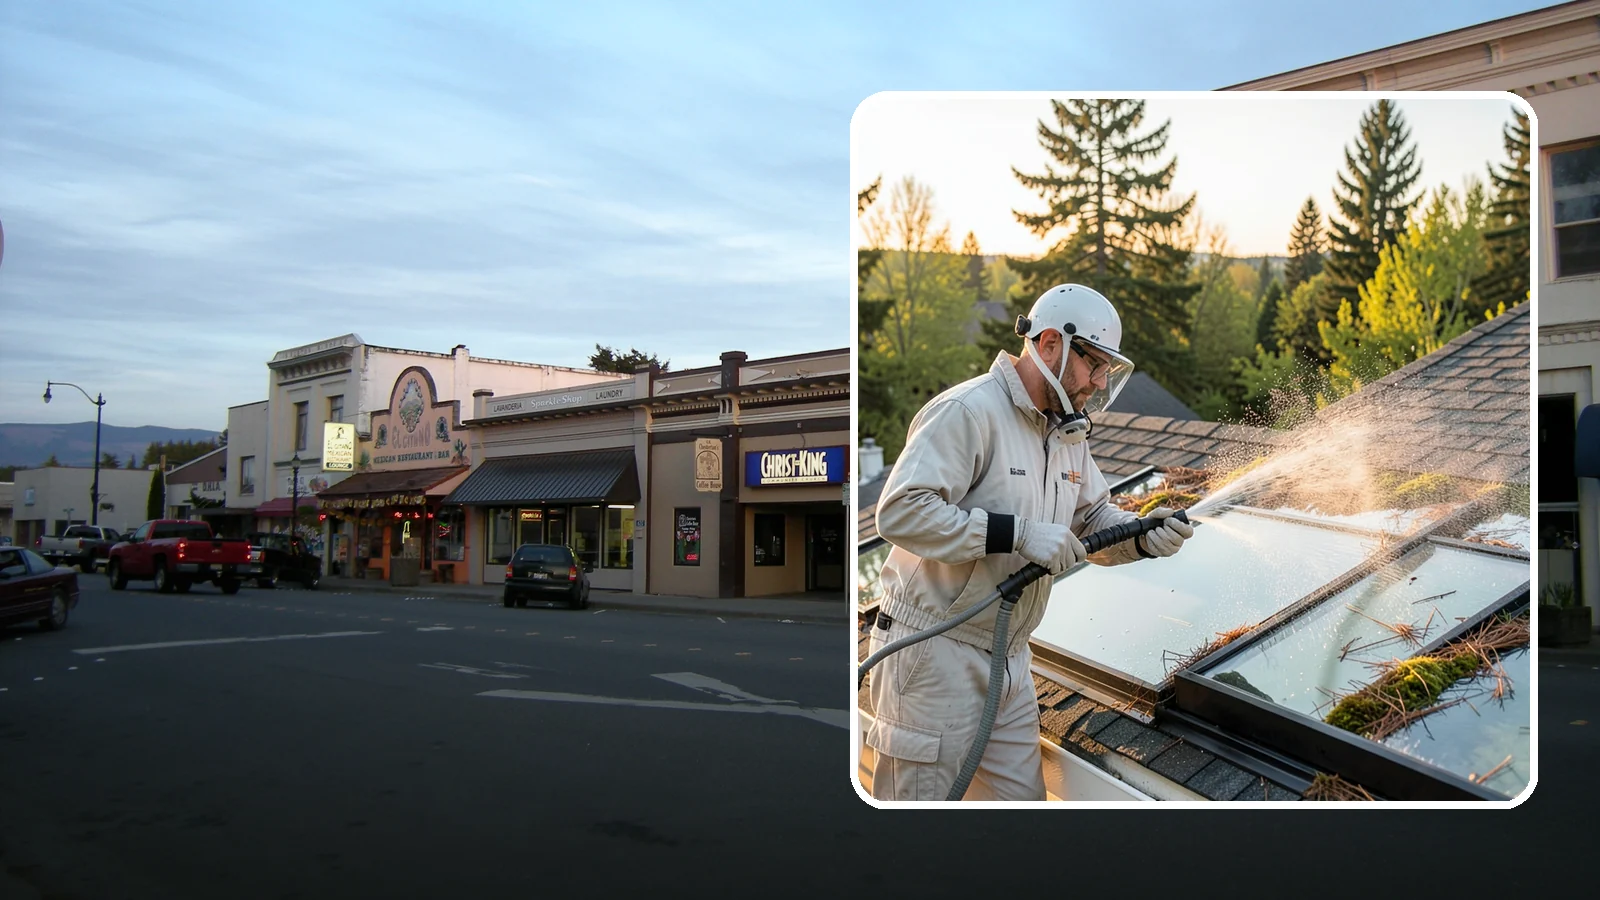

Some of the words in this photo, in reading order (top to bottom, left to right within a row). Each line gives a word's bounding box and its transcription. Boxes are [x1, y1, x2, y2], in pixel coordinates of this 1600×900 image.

[595, 389, 623, 399] LAUNDRY
[493, 402, 522, 413] LAVANDERIA
[531, 398, 561, 409] Sparkle
[562, 394, 582, 405] Shop
[397, 451, 433, 463] RESTAURANT
[438, 450, 450, 459] BAR
[799, 450, 827, 476] KING
[761, 452, 797, 478] CHRIST
